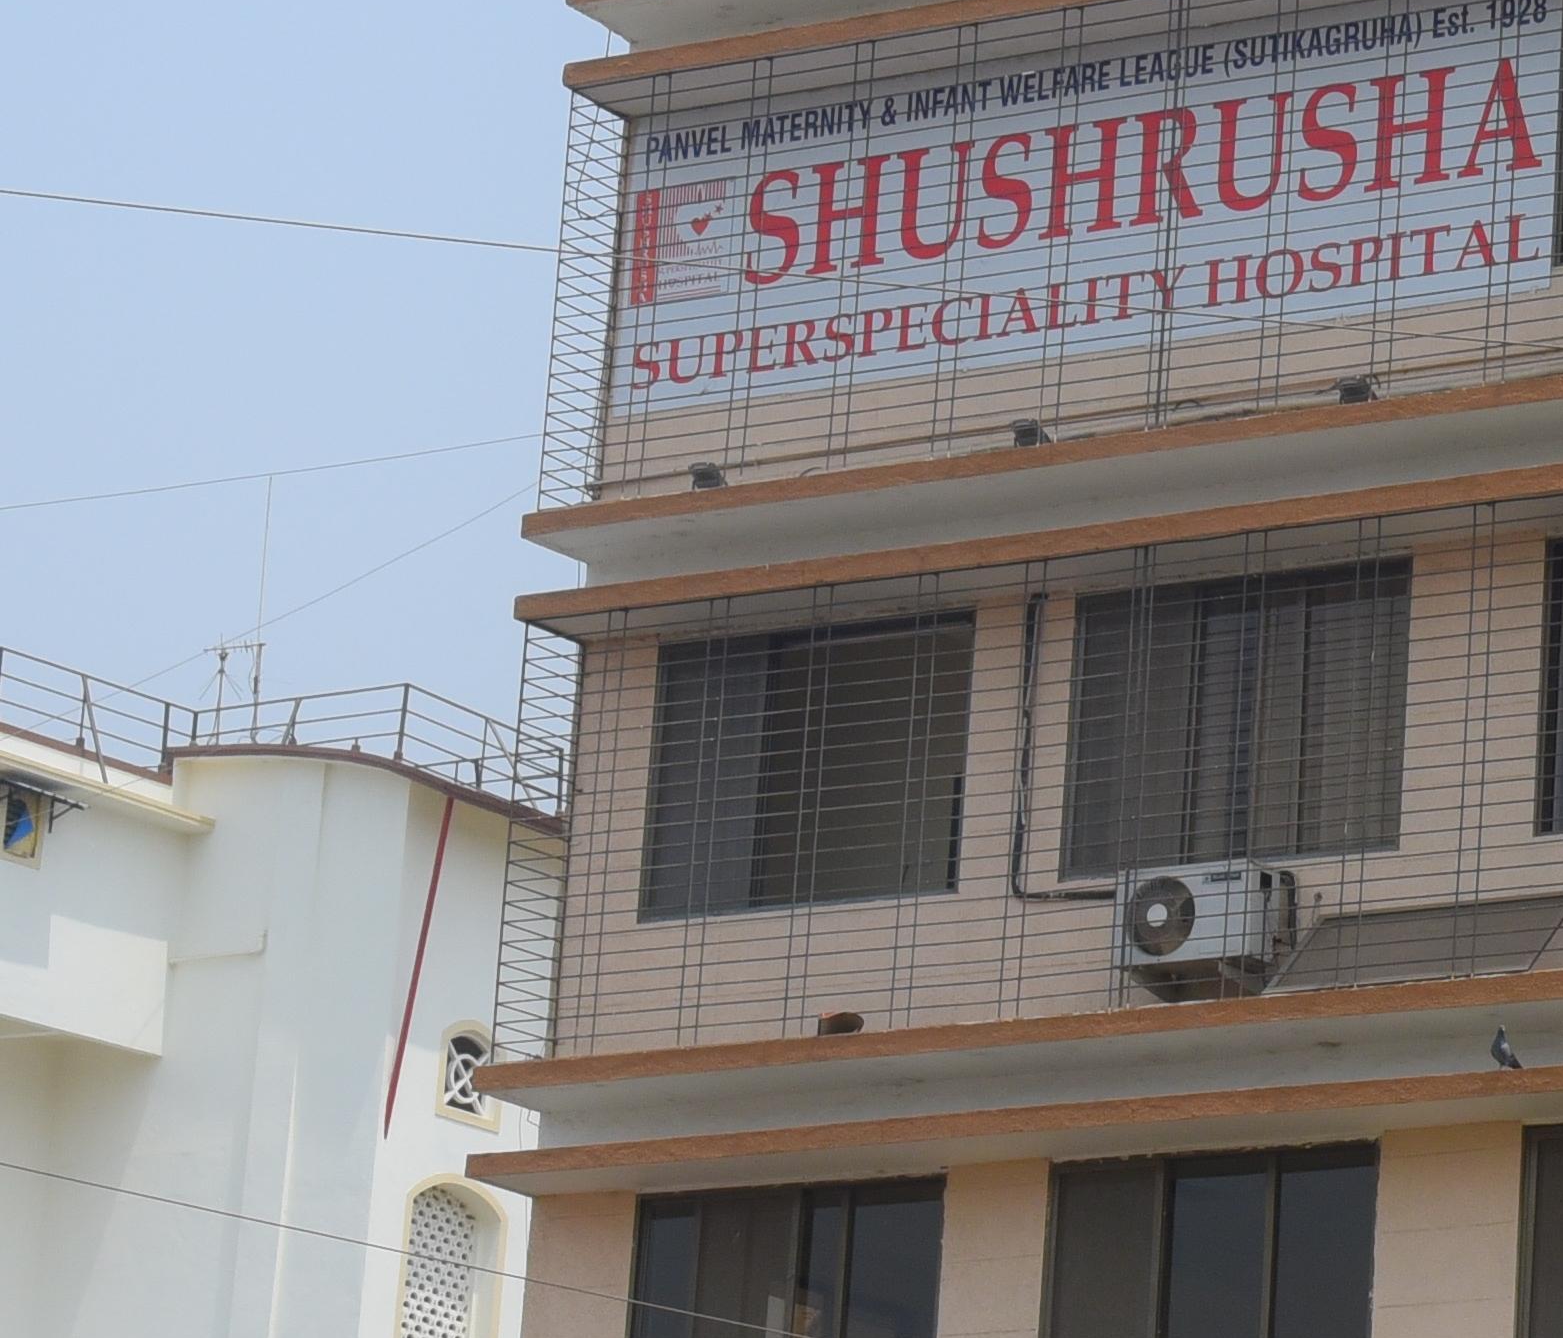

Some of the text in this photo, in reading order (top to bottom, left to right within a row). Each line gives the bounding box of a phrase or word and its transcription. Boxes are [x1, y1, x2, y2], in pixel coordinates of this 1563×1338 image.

[645, 127, 732, 167] PANVEL
[741, 101, 871, 150] MATERNITY
[881, 97, 898, 127] &
[907, 80, 992, 123] INFANT
[1000, 61, 1111, 107] WELFARE
[1119, 43, 1214, 92] LEAGUE
[1225, 13, 1423, 78] (SUTIKAGRUHA)
[1432, 4, 1475, 38] Est.
[746, 57, 1542, 285] SHUSHRUSHA
[632, 213, 1542, 390] SUPERSPECIALITY HOSPITAL
